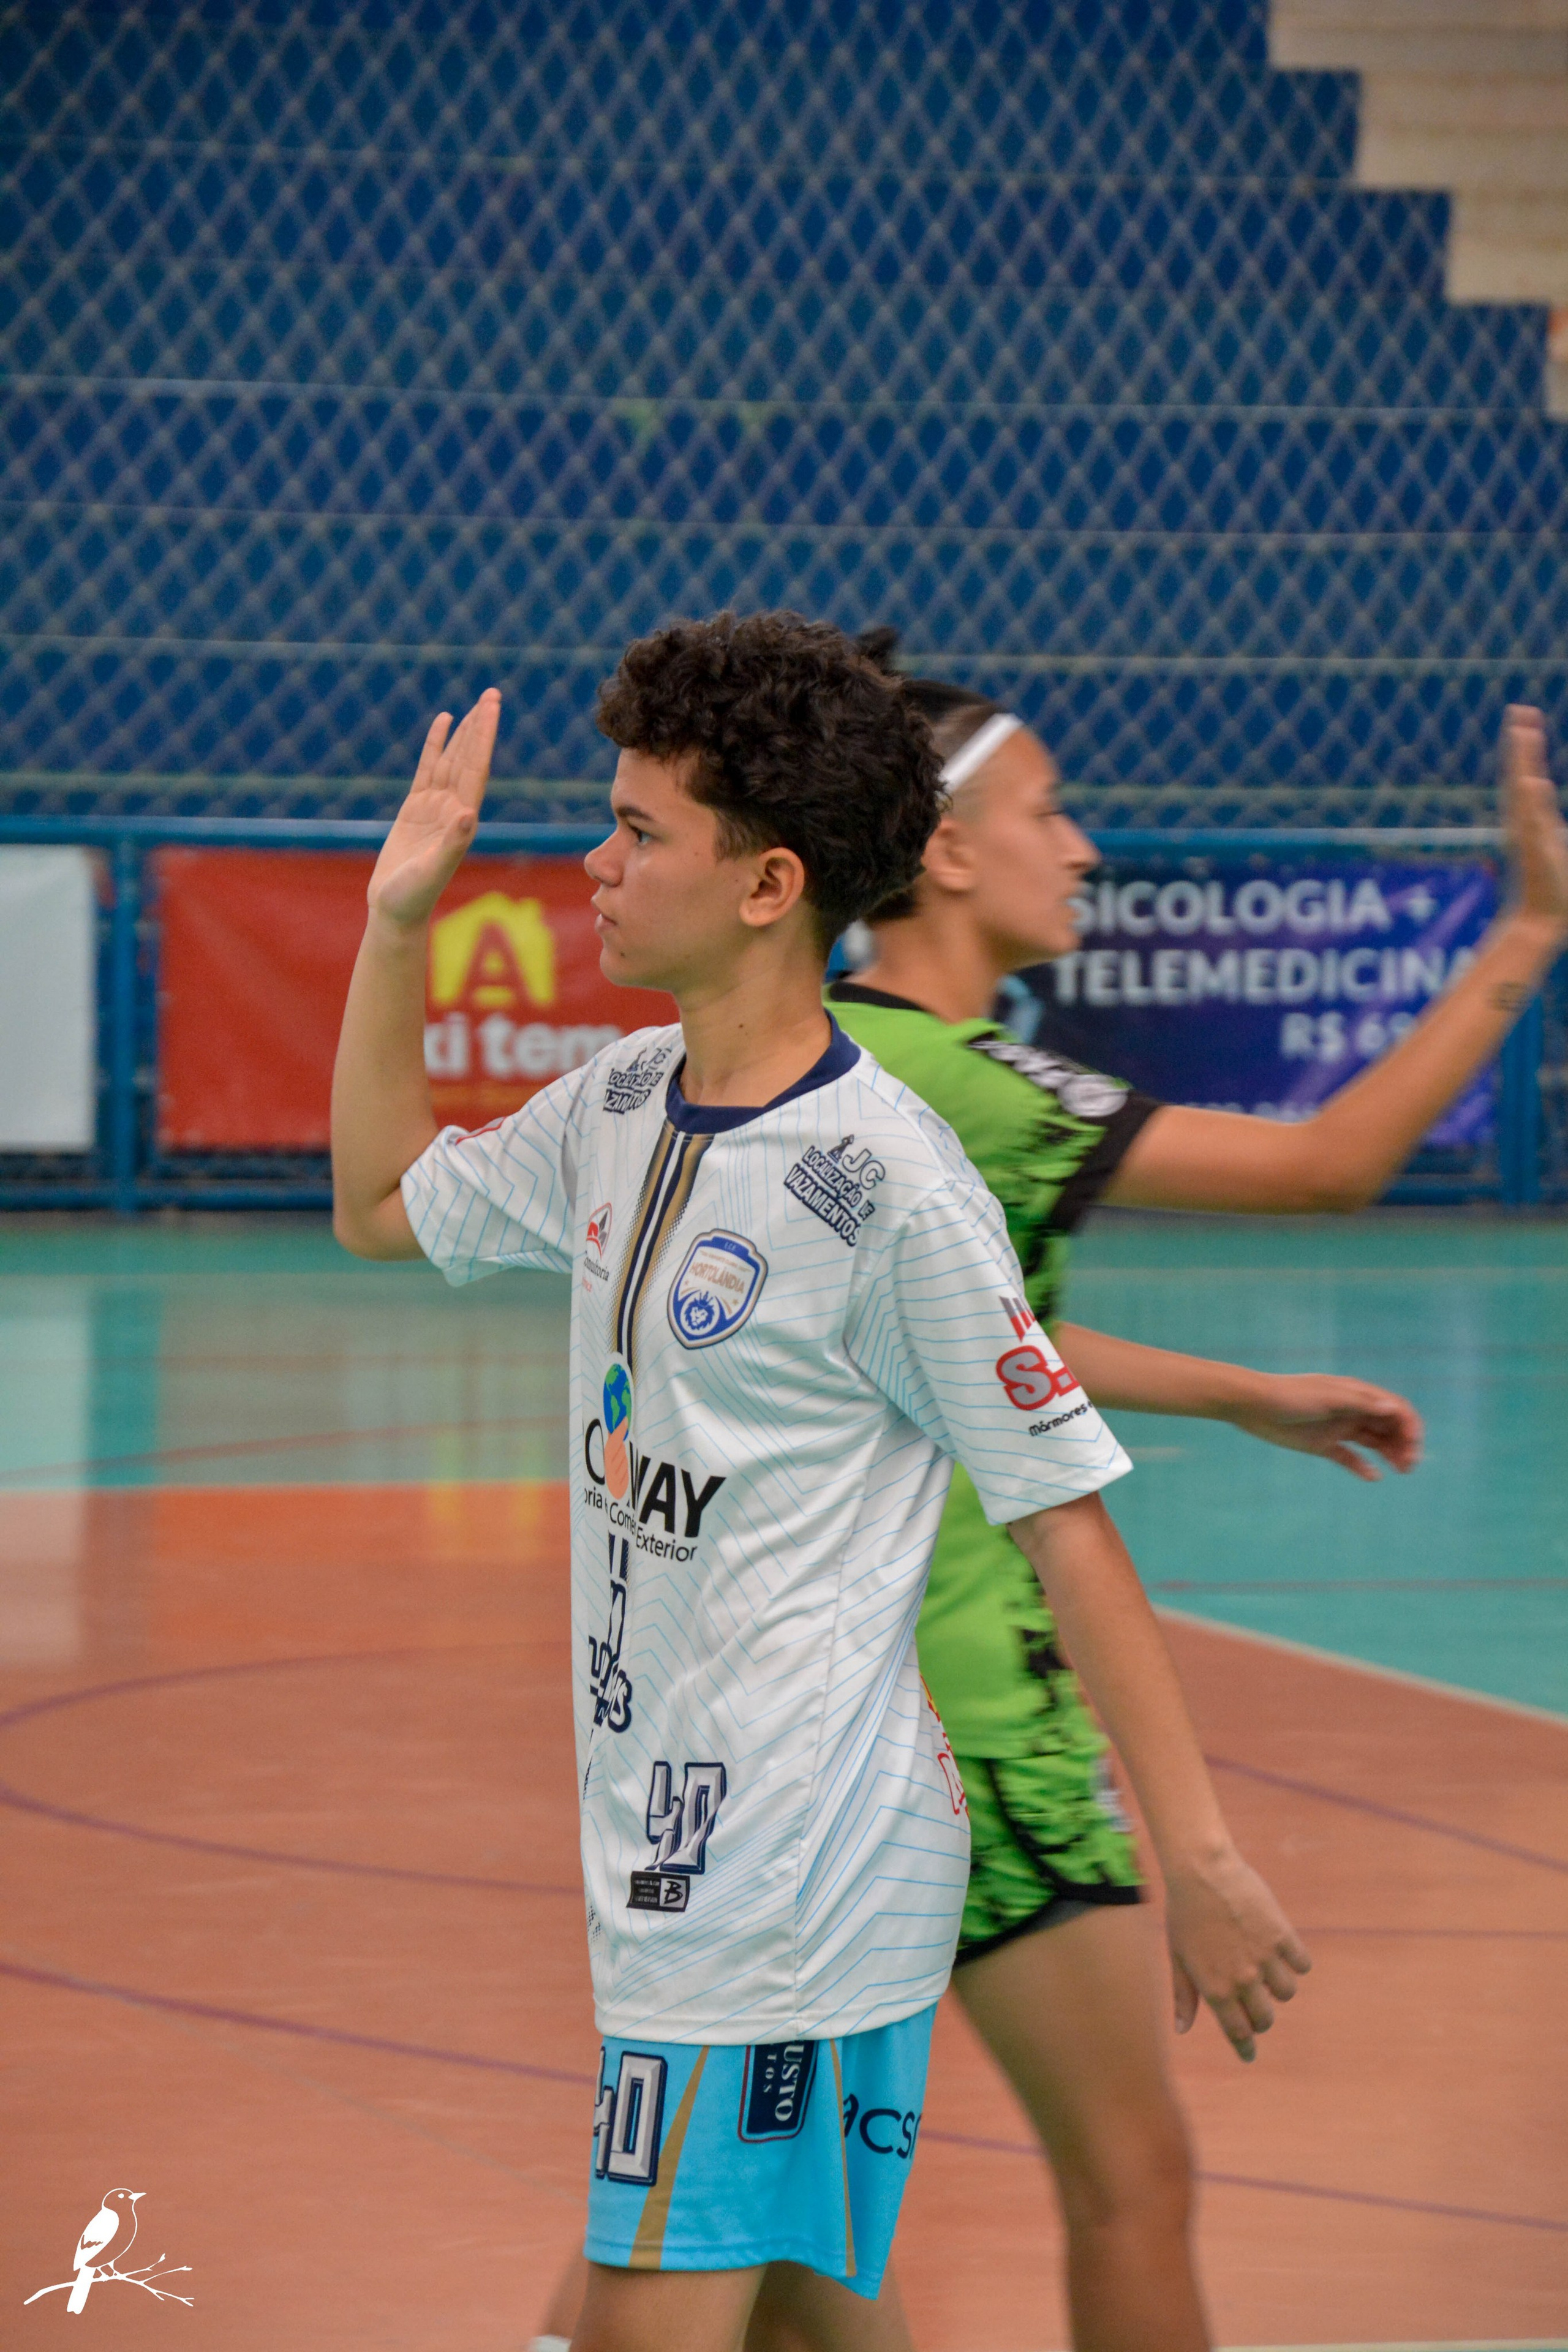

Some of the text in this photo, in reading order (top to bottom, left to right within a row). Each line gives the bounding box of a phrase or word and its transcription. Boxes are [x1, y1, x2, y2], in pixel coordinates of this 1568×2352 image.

[1066, 880, 1393, 936] SICOLOGIA
[842, 1148, 886, 1191] JC
[1029, 1403, 1088, 1437] mármores
[636, 1526, 698, 1562] Exterior
[763, 2053, 778, 2094] TOS
[774, 2044, 805, 2122] USTO
